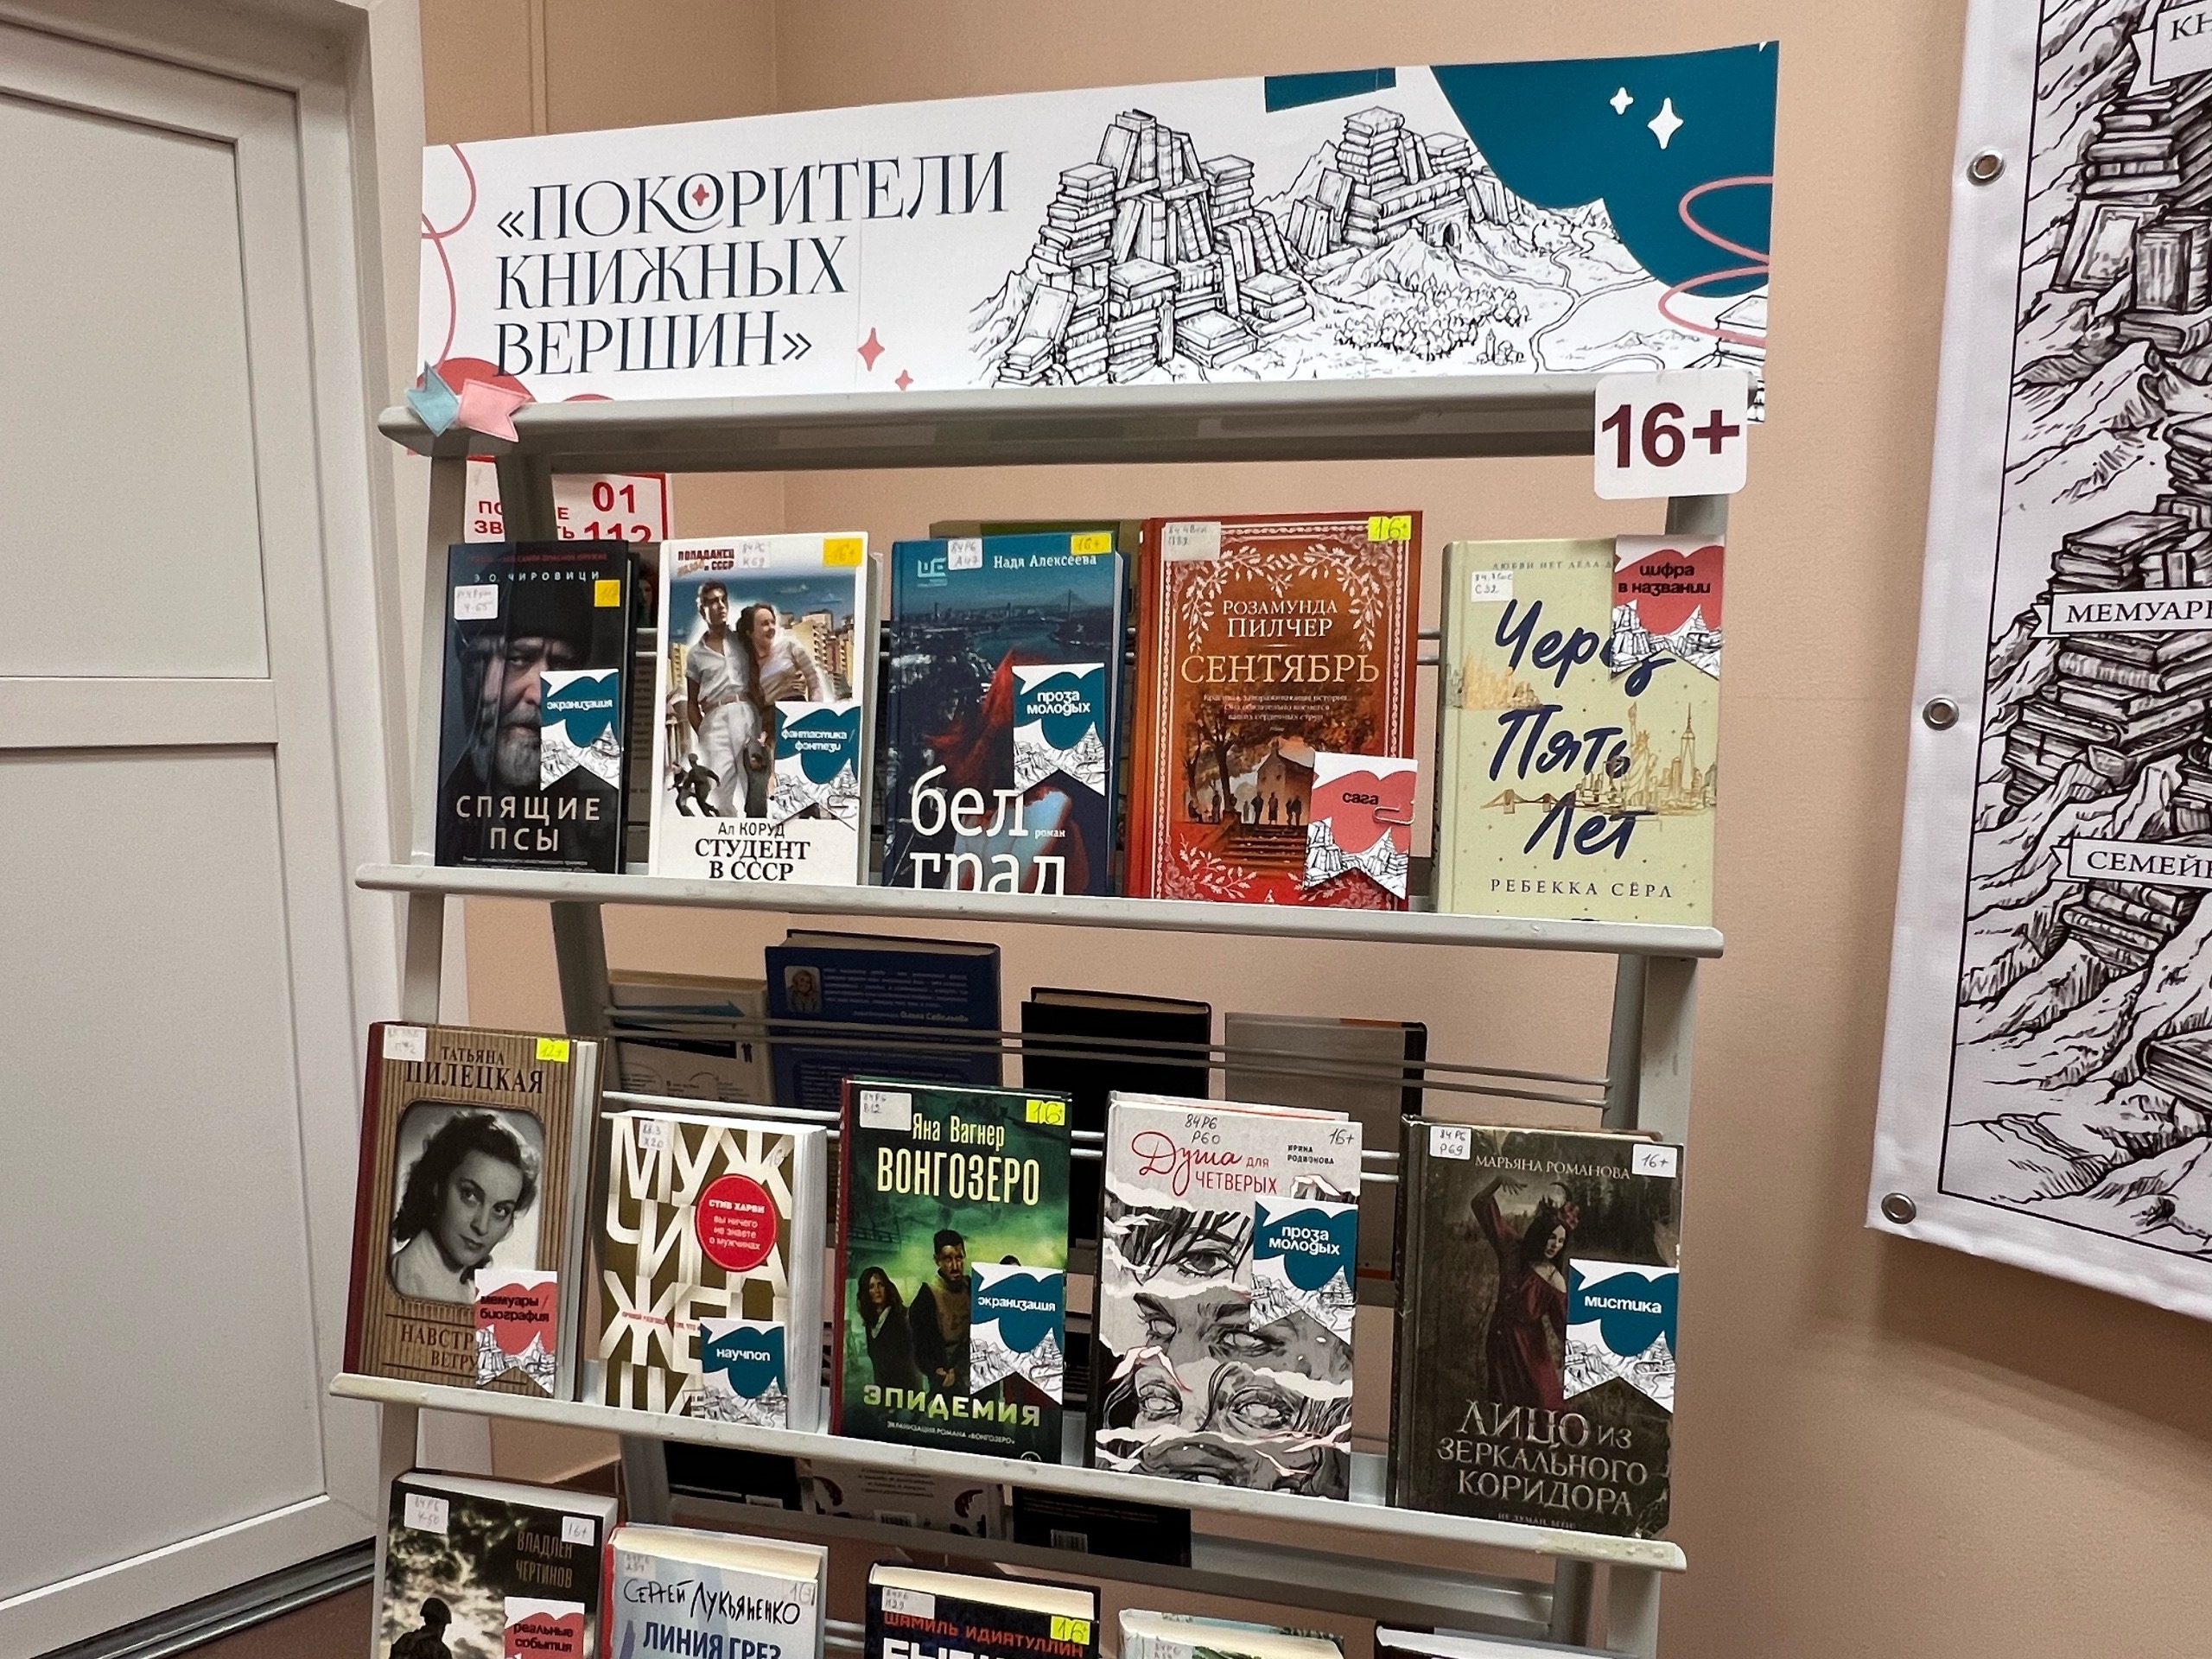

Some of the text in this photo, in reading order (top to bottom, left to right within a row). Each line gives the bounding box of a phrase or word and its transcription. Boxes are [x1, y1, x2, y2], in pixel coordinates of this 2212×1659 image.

[497, 150, 1009, 241] «ПОКОРИТЕЛИ
[493, 235, 849, 310] КНИЖНЫХ
[493, 310, 812, 377] ВЕРШИН»
[1602, 403, 1740, 468] 16+
[592, 481, 635, 514] 01
[584, 521, 652, 542] 112
[995, 554, 1097, 569] Надя Алексеева
[1639, 563, 1695, 579] цифра
[508, 570, 600, 582] ЧИРОВИЦИ
[1618, 581, 1711, 597] в названии
[1222, 599, 1338, 617] РОЗАМУНДА
[2065, 601, 2212, 623] МЕМУАР
[1228, 617, 1333, 639] ПИЛЧЕР
[1181, 653, 1380, 683] СЕНТЯБРЬ
[546, 700, 613, 711] экранизация
[1037, 690, 1080, 705] проза
[1027, 702, 1090, 716] молодых
[781, 729, 848, 741] фантастика
[1489, 704, 1631, 781] Пять
[795, 740, 842, 753] фэнтези
[911, 765, 1028, 837] бел
[1342, 791, 1379, 805] сага
[456, 795, 601, 826] СПЯЩИЕ
[718, 822, 785, 838] Ал КОРУД
[1034, 829, 1066, 839] роман
[1523, 791, 1659, 861] Лет
[490, 827, 558, 851] ПСЫ
[695, 838, 810, 864] СТУДЕНТ
[709, 861, 794, 881] В СССР
[2087, 851, 2212, 878] СЕМЕЙ
[1491, 878, 1598, 896] РЕБЕККА
[442, 1046, 505, 1065] ТАТЬЯНА
[406, 1061, 544, 1095] ПИЛЕЦКАЯ
[1184, 1113, 1217, 1130] 84Р6
[912, 1112, 1005, 1152] Яна Вагнер
[1192, 1130, 1221, 1145] Р60
[1329, 1128, 1355, 1147] 16+
[1287, 1143, 1313, 1154] ИРИНА
[1440, 1143, 1464, 1157] Р69
[609, 1116, 796, 1220] МУЖ
[1131, 1130, 1270, 1197] Душа для
[1287, 1154, 1334, 1166] РОДИОНОВА
[1475, 1154, 1630, 1180] МАРЬЯНА РОМАНОВА
[1641, 1153, 1669, 1168] 16+
[877, 1147, 1040, 1206] ВОНГОЗЕРО
[1196, 1170, 1277, 1195] ЧЕТВЕРЫХ
[709, 1198, 766, 1215] СТИВ ХАРВИ
[1281, 1225, 1329, 1243] проза
[1268, 1237, 1341, 1256] молодых
[480, 1295, 540, 1308] мемуары
[977, 1295, 1056, 1312] экранизация
[1584, 1294, 1662, 1314] мистика
[480, 1308, 550, 1324] биография
[400, 1323, 475, 1351] НАВСТР
[716, 1348, 771, 1362] научпоп
[863, 1384, 1041, 1427] ЭПИДЕМИЯ
[1455, 1398, 1633, 1451] ЛИЦО ИЗ
[1436, 1437, 1649, 1486] ЗЕРКАЛЬНОГО
[1458, 1469, 1633, 1516] КОРИДОРА
[517, 1530, 573, 1560] ВЛАДЛЕН
[516, 1560, 573, 1588] ЧЕРТИНОВ
[513, 1623, 574, 1637] реальные
[643, 1621, 723, 1659] ЛИНИЯ
[884, 1611, 959, 1637] ШАМИЛЬ
[964, 1624, 1084, 1658] ИДИАТУЛЛИН
[514, 1637, 572, 1653] события
